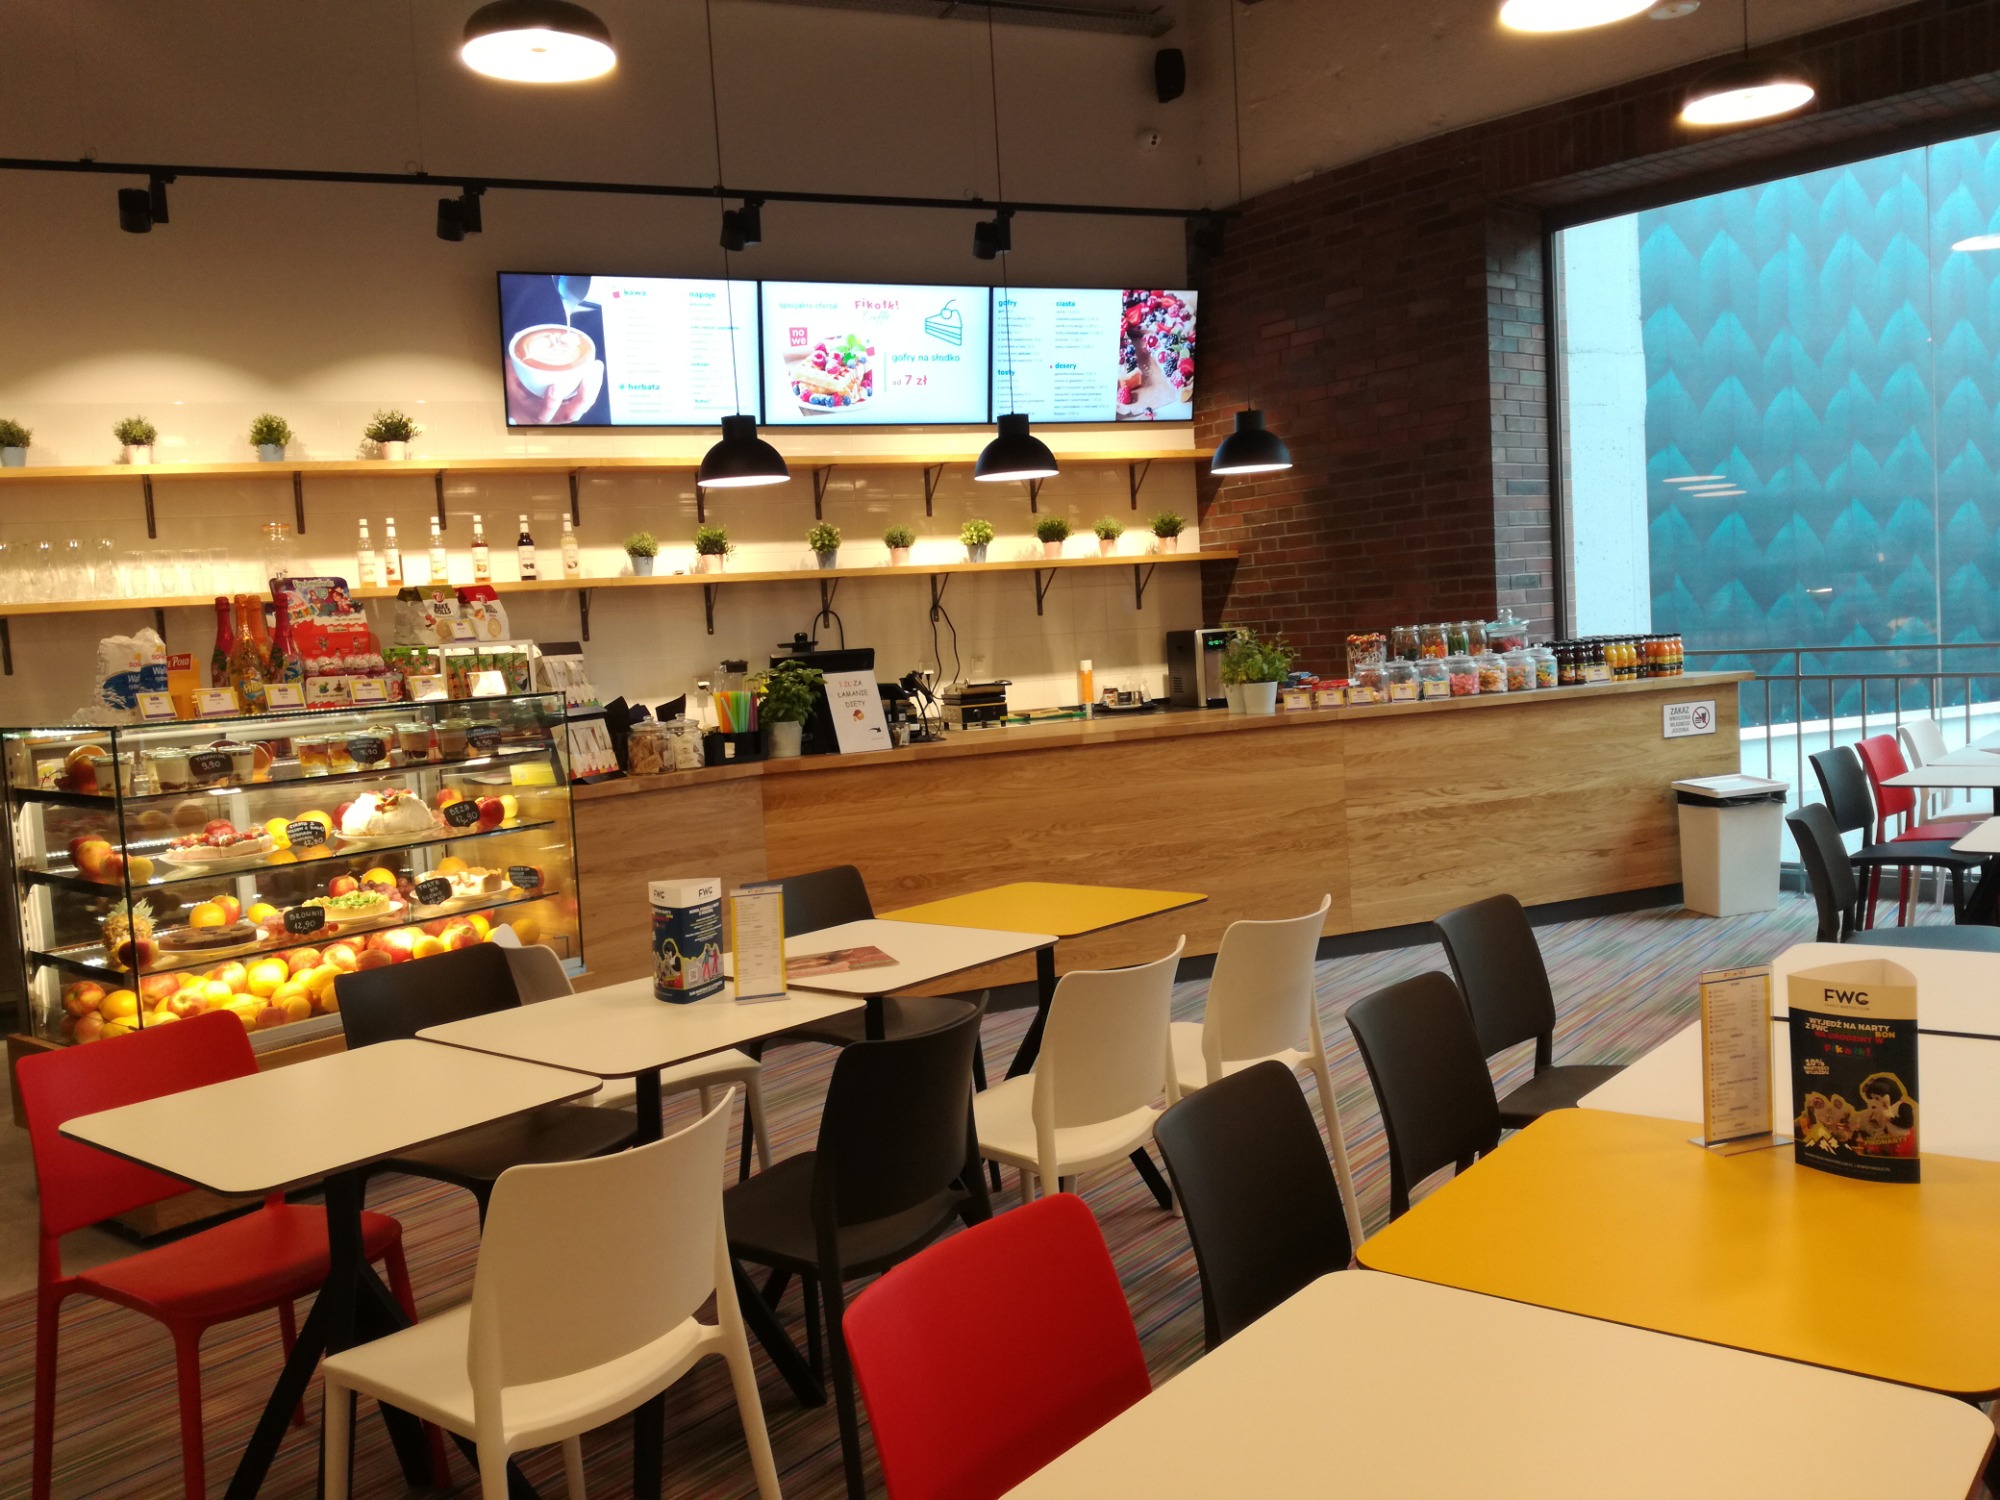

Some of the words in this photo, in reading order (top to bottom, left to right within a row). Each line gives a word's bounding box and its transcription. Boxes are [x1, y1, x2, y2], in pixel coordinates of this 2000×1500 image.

[624, 288, 647, 296] kawa
[689, 291, 717, 299] napoje
[779, 302, 814, 310] specjalna
[891, 353, 916, 362] gofry
[931, 352, 961, 362] słodko
[1055, 362, 1077, 370] desery
[892, 378, 902, 386] od
[904, 375, 913, 386] 7
[916, 375, 928, 386] zł
[628, 383, 661, 391] herbata
[1671, 706, 1689, 715] ZAKAZ
[653, 889, 665, 899] FWC
[698, 886, 713, 898] FWC
[289, 910, 323, 920] BROWNIE
[1824, 988, 1870, 1006] FWC
[1808, 1017, 1842, 1028] WYJEDŹ
[1843, 1022, 1857, 1030] NA
[1858, 1023, 1890, 1032] NARTY
[1811, 1025, 1829, 1033] FWC
[1875, 1031, 1895, 1039] BON
[1805, 1059, 1825, 1067] 10%
